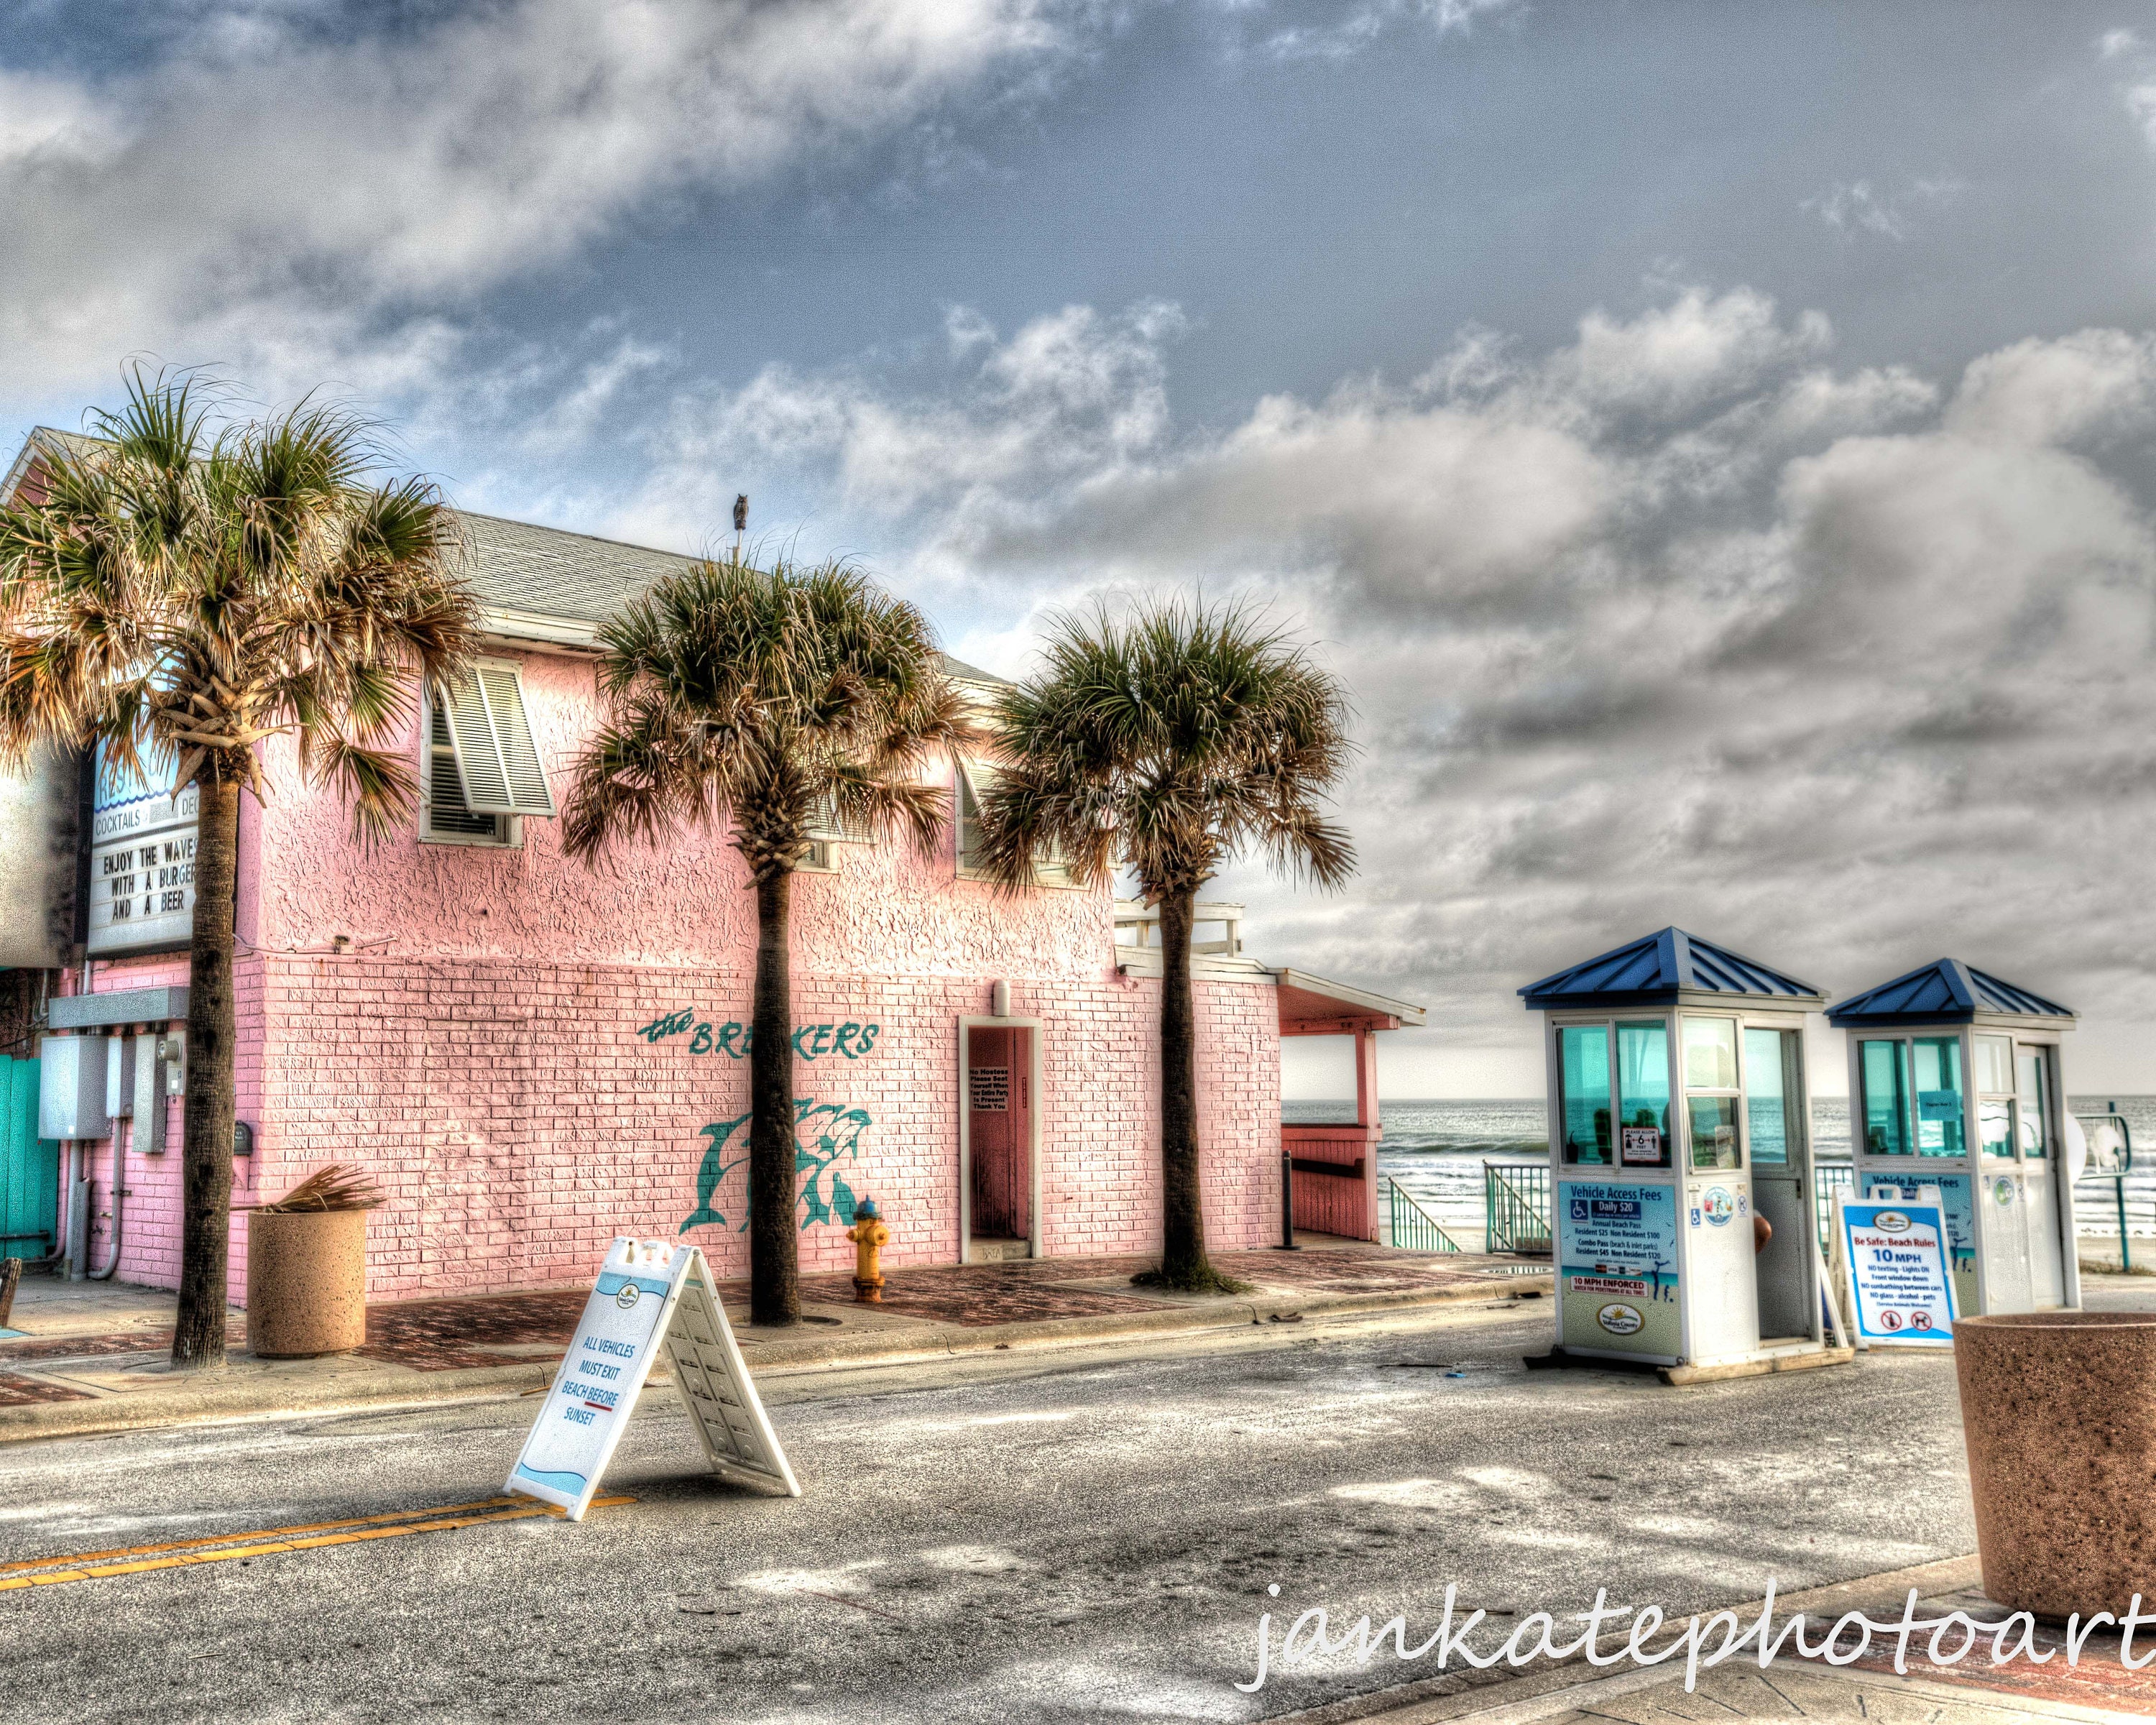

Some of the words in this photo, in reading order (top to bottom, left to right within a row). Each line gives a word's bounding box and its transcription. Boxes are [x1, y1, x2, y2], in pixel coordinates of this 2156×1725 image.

[96, 809, 139, 836] COCKTAILS
[182, 795, 198, 816] DEC
[103, 850, 133, 875] ENJOY
[139, 845, 157, 867] THE
[112, 874, 134, 896] WITH
[146, 871, 152, 891] A
[160, 863, 195, 888] BURGER
[112, 899, 131, 920] AND
[144, 896, 150, 914] A
[161, 891, 183, 912] BEER
[637, 1006, 694, 1043] the
[688, 1021, 880, 1062] BREKERS
[1639, 1135, 1644, 1144] 6
[1873, 1176, 1904, 1185] Vehicle
[1938, 1177, 1958, 1187] Fees
[1571, 1185, 1604, 1198] Vehicle
[1607, 1187, 1637, 1200] Access
[1639, 1188, 1662, 1201] Fees
[1599, 1201, 1618, 1213] Daily
[1620, 1202, 1633, 1212] $20
[1888, 1238, 1912, 1246] Beach
[1914, 1238, 1935, 1247] Rules
[1873, 1249, 1892, 1262] 10
[1896, 1254, 1921, 1263] MPH
[1603, 1279, 1644, 1289] ENFORCED
[1871, 1283, 1903, 1292] sunbathing
[583, 1336, 598, 1351] ALL
[598, 1339, 635, 1358] VEHICLES
[579, 1360, 603, 1376] MUST
[601, 1366, 621, 1380] EXIT
[562, 1381, 589, 1398] BEACH
[587, 1387, 619, 1406] BEFORE
[564, 1407, 596, 1426] SUNSET
